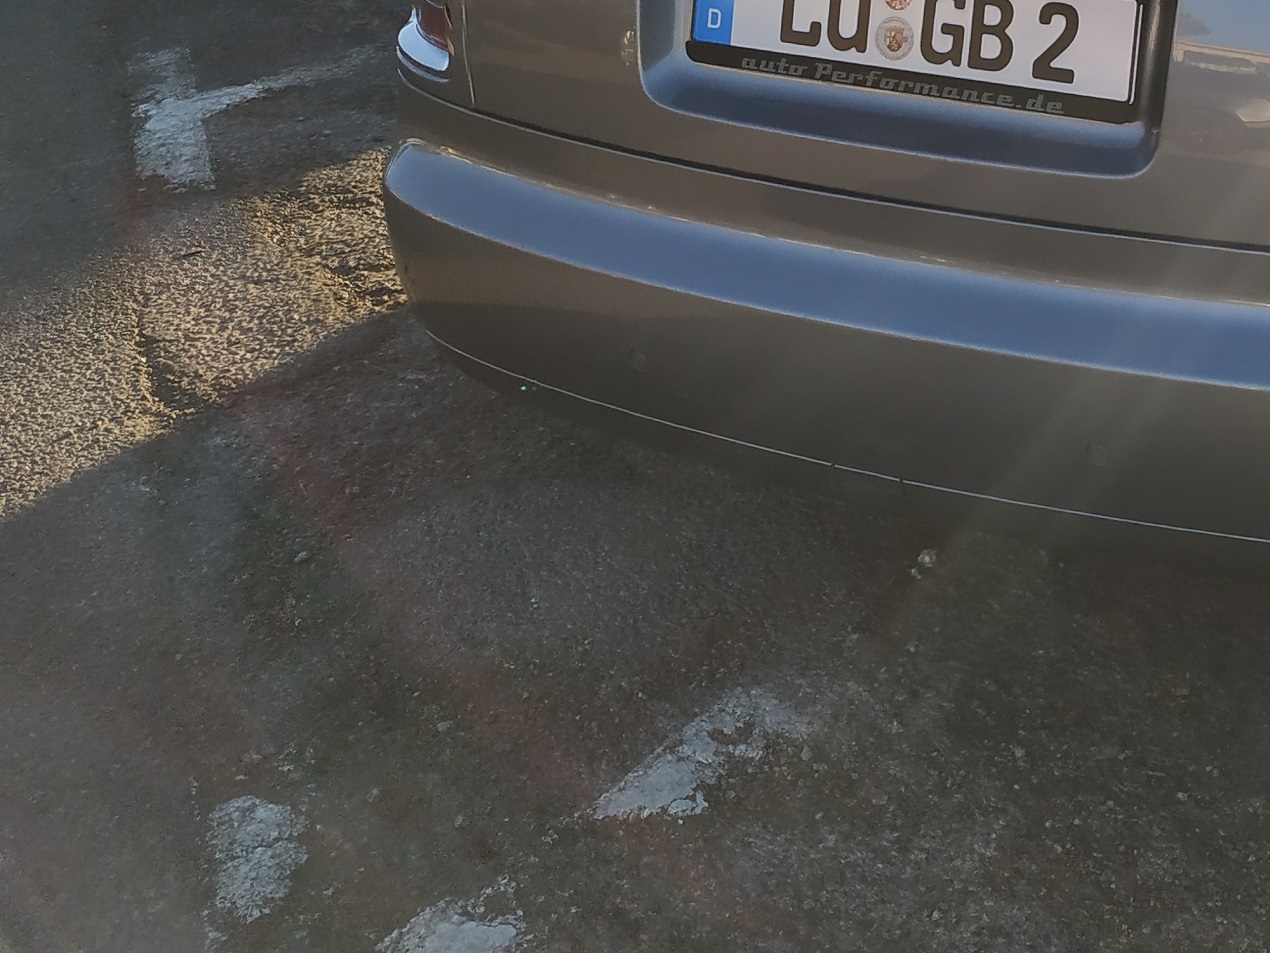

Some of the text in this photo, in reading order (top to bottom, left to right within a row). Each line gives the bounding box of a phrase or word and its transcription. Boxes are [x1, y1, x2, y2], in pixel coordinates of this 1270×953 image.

[706, 7, 723, 30] D
[1031, 1, 1080, 85] 2
[741, 56, 1066, 115] auto Performance.de
